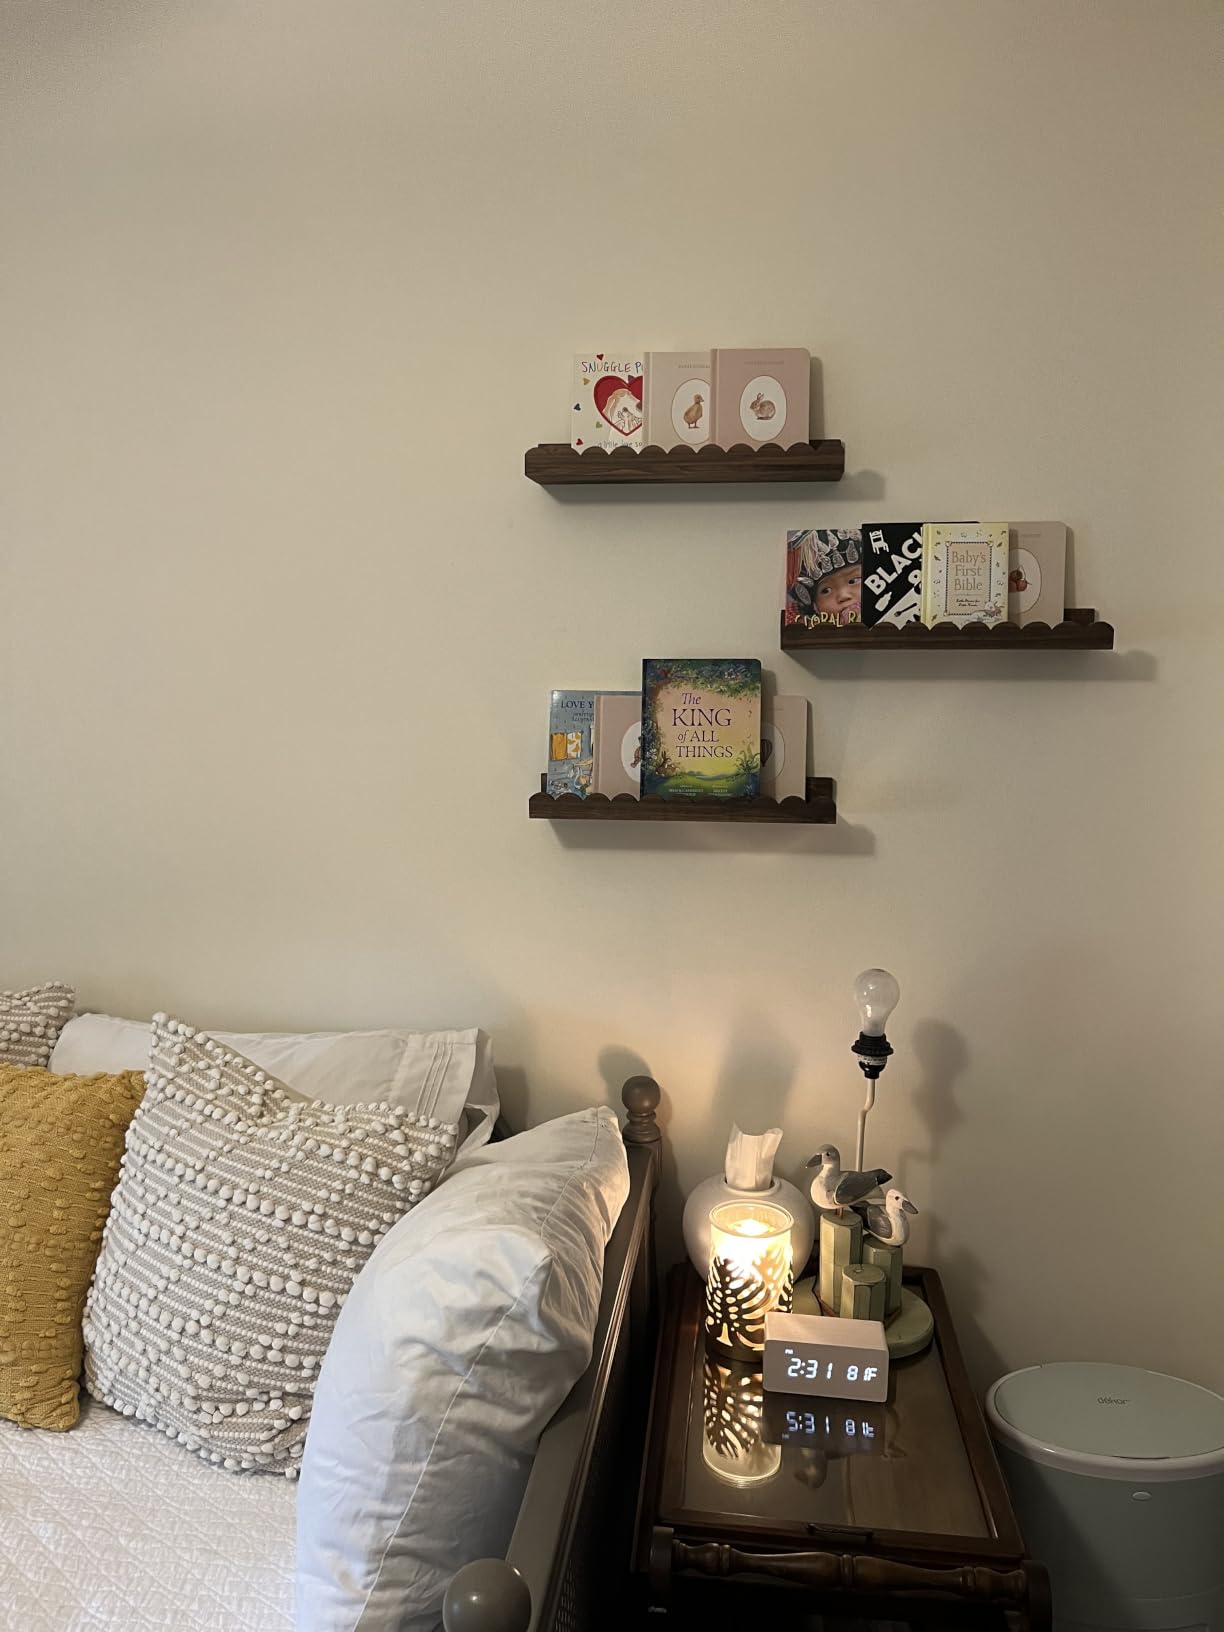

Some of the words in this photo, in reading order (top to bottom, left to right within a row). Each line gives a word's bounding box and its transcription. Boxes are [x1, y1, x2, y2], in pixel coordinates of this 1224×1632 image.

[581, 361, 631, 373] SNUGGLE
[951, 550, 986, 567] Baby's
[955, 564, 982, 577] First
[954, 577, 983, 591] Bible
[561, 700, 586, 709] LOVE
[681, 692, 702, 705] The
[671, 708, 732, 727] KING
[677, 729, 690, 744] of
[690, 730, 720, 743] ALL
[675, 745, 733, 758] THINGS
[787, 1357, 833, 1380] 2:31
